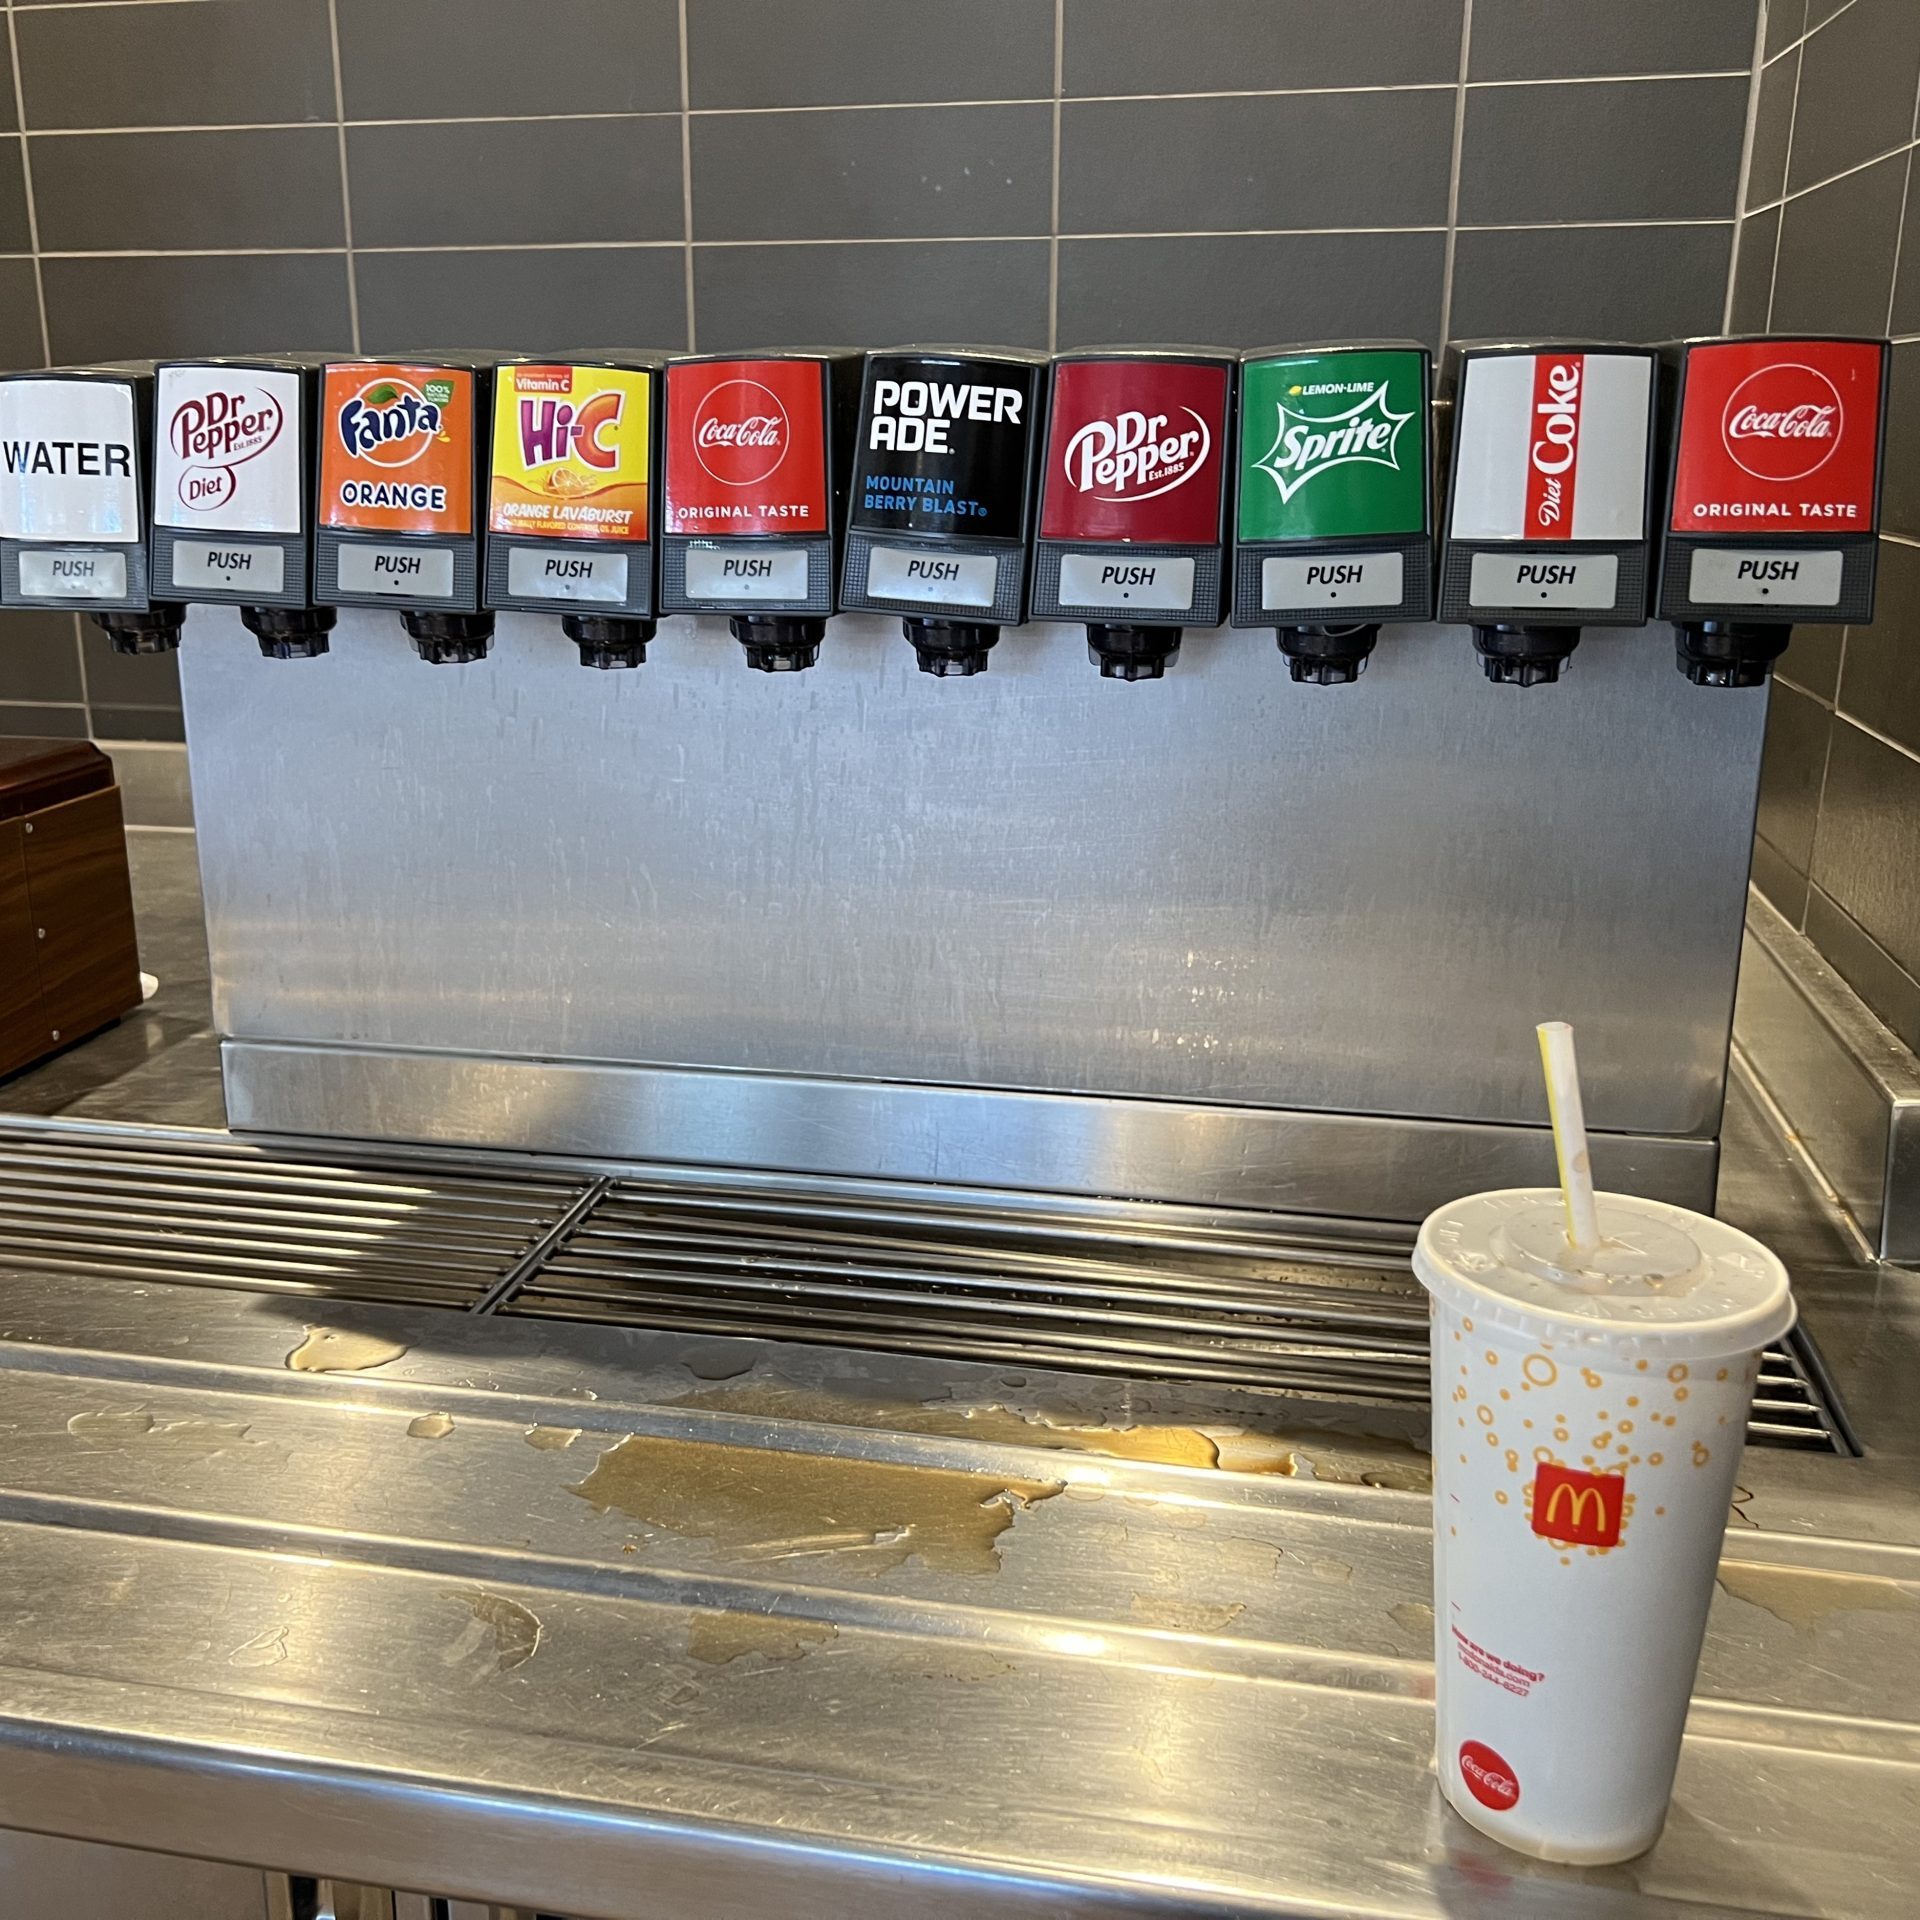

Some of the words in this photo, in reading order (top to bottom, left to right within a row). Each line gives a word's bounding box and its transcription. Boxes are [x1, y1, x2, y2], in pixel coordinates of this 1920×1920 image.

[516, 378, 560, 391] Vitamin
[560, 379, 570, 392] C
[1303, 382, 1374, 396] LEMON-LIME
[206, 392, 245, 427] Dr
[873, 380, 1023, 425] POWER
[170, 399, 273, 460] Pepper
[340, 394, 440, 456] Fanta
[1532, 364, 1580, 476] Coke
[1728, 403, 1836, 440] Coca-Cola
[519, 393, 622, 469] Hi-C
[698, 415, 780, 448] Coca-Cola
[1116, 411, 1168, 452] Dr
[1273, 416, 1390, 471] Sprite
[3, 440, 131, 477] WATER
[1064, 420, 1199, 492] Pepper
[189, 477, 222, 500] Diet
[341, 481, 446, 509] ORANGE
[865, 475, 955, 494] MOUNTAIN
[677, 505, 752, 519] ORIGINAL
[758, 505, 810, 518] TASTE
[864, 495, 918, 511] BERRY
[1538, 477, 1562, 527] Diet
[1693, 502, 1792, 518] ORIGINAL
[1799, 502, 1857, 519] TASTE
[503, 503, 552, 518] ORANGE
[553, 505, 633, 524] LAVABURST
[52, 560, 95, 577] PUSH
[207, 551, 251, 570] PUSH
[374, 555, 421, 574] PUSH
[545, 559, 592, 578] PUSH
[723, 560, 772, 577] PUSH
[907, 560, 960, 581] PUSH
[1737, 560, 1800, 581] PUSH
[1101, 566, 1155, 586] PUSH
[1306, 565, 1363, 585] PUSH
[1516, 565, 1577, 585] PUSH
